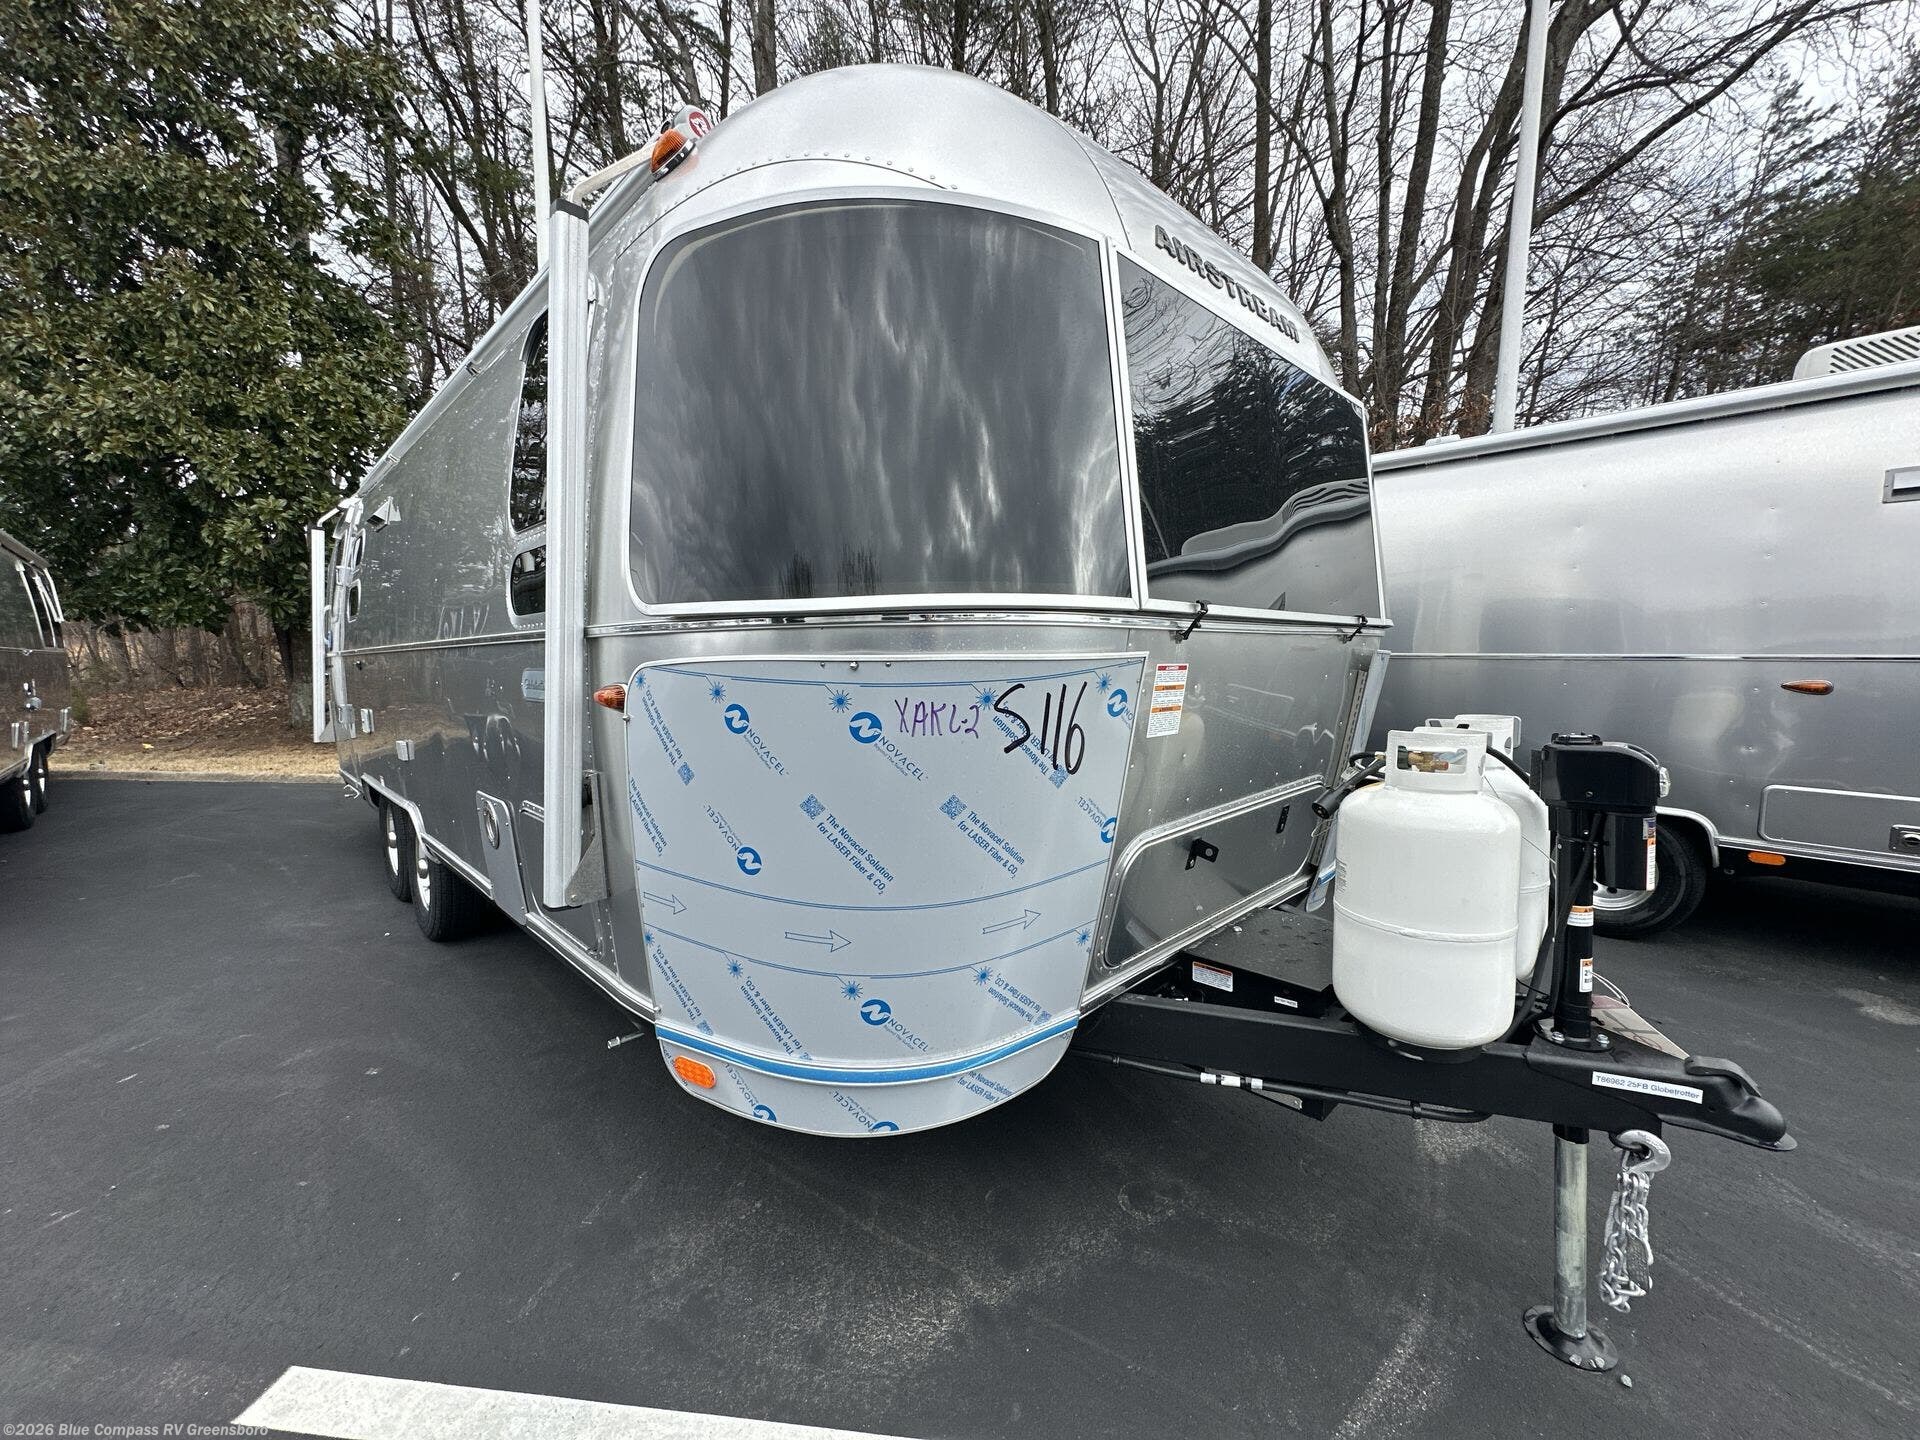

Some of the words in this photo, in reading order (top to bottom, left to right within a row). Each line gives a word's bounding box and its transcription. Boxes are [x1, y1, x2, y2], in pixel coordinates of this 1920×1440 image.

[1154, 224, 1300, 344] AIRSTREAM
[747, 729, 784, 775] NOVACEL
[879, 736, 923, 781] NOVACEL
[1019, 741, 1040, 766] Novace
[1038, 762, 1049, 775] The
[707, 805, 739, 851] NOVACEL
[1078, 797, 1103, 828] NOVACEL
[817, 822, 829, 834] for
[827, 833, 851, 858] LASER
[849, 856, 868, 874] Fiber
[826, 814, 839, 829] The
[839, 827, 868, 855] Novacel
[865, 854, 894, 882] Solution
[958, 820, 969, 832] for
[968, 830, 990, 850] LASER
[988, 847, 1004, 863] Fiber
[967, 811, 980, 825] The
[979, 822, 1005, 845] Novacel
[1002, 842, 1025, 865] Solution
[740, 985, 762, 1015] Solution
[760, 998, 774, 1016] Fiber
[760, 1014, 784, 1043] Novacel
[773, 1016, 793, 1039] LASER
[888, 1018, 928, 1052] NOVACEL
[782, 1042, 794, 1056] The
[792, 1039, 802, 1050] for
[1650, 1084, 1699, 1099] Globetrotter
[833, 1091, 873, 1128] NOVACEL
